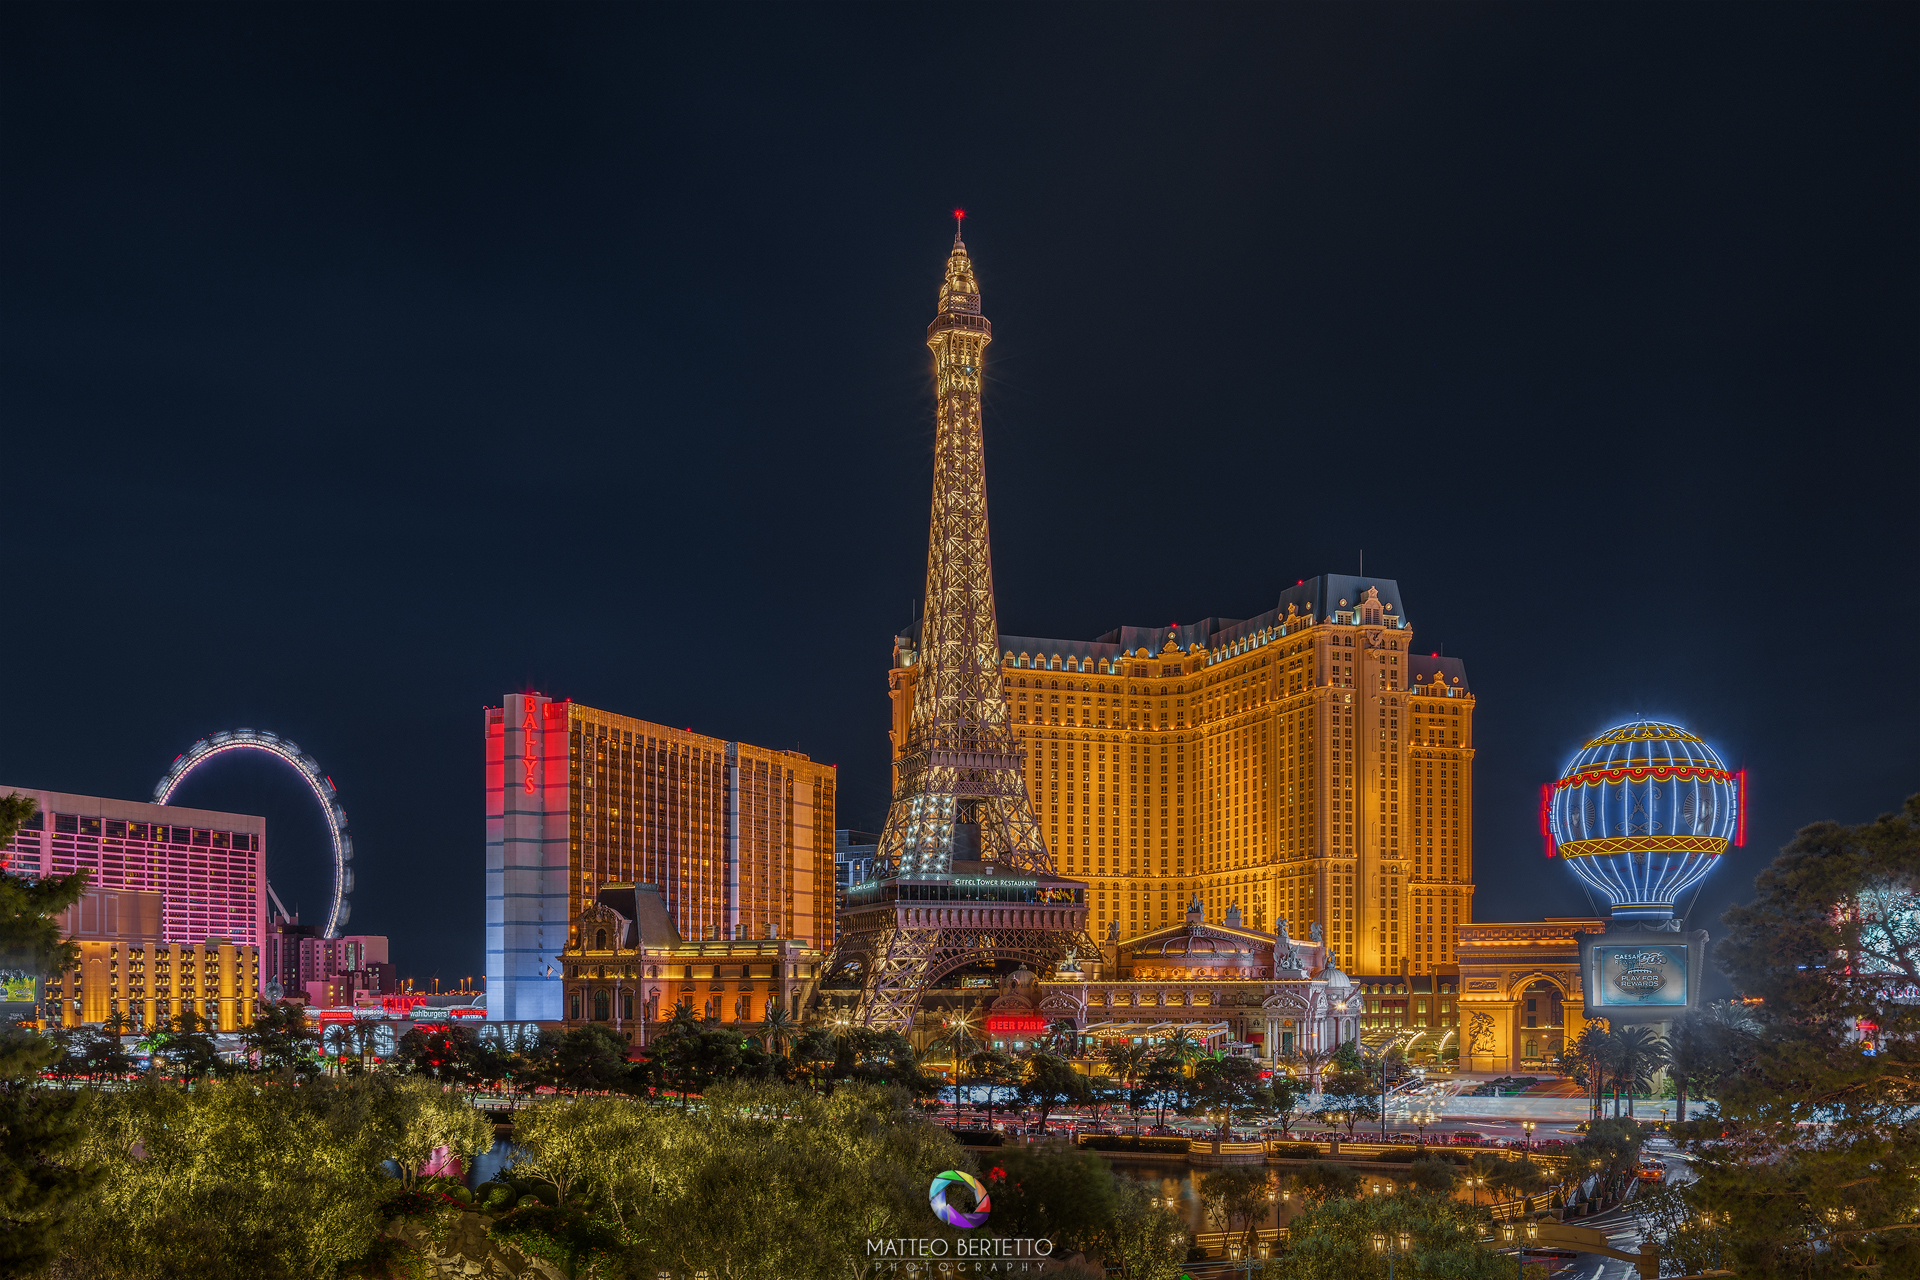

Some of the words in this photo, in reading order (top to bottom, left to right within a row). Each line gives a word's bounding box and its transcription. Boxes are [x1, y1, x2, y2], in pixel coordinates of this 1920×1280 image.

[522, 696, 538, 794] BALLYS
[410, 1010, 447, 1018] wahlburgers
[990, 1021, 1015, 1030] BEER
[1017, 1021, 1044, 1030] PARK
